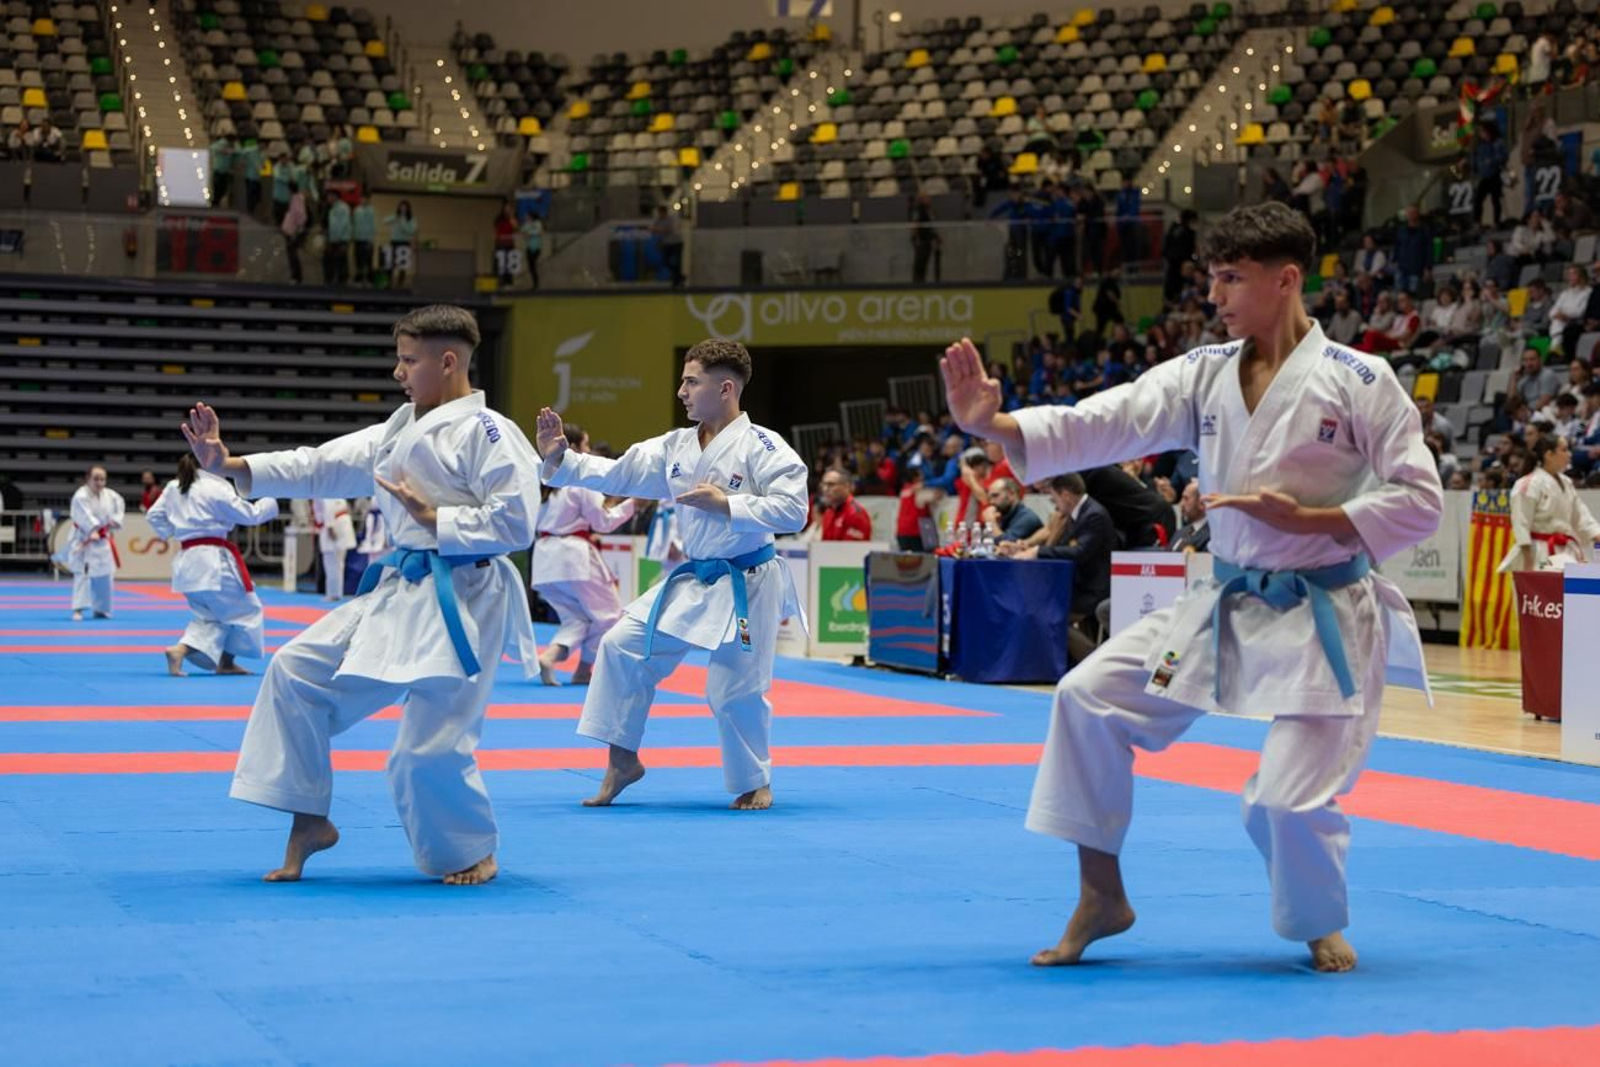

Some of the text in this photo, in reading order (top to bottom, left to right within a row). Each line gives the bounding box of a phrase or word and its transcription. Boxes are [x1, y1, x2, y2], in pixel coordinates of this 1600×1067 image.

[386, 154, 489, 184] Salida 7
[1536, 166, 1561, 200] 22
[1448, 181, 1473, 214] 22
[383, 244, 412, 271] 18
[495, 249, 522, 275] 18
[760, 292, 974, 325] olivo arena
